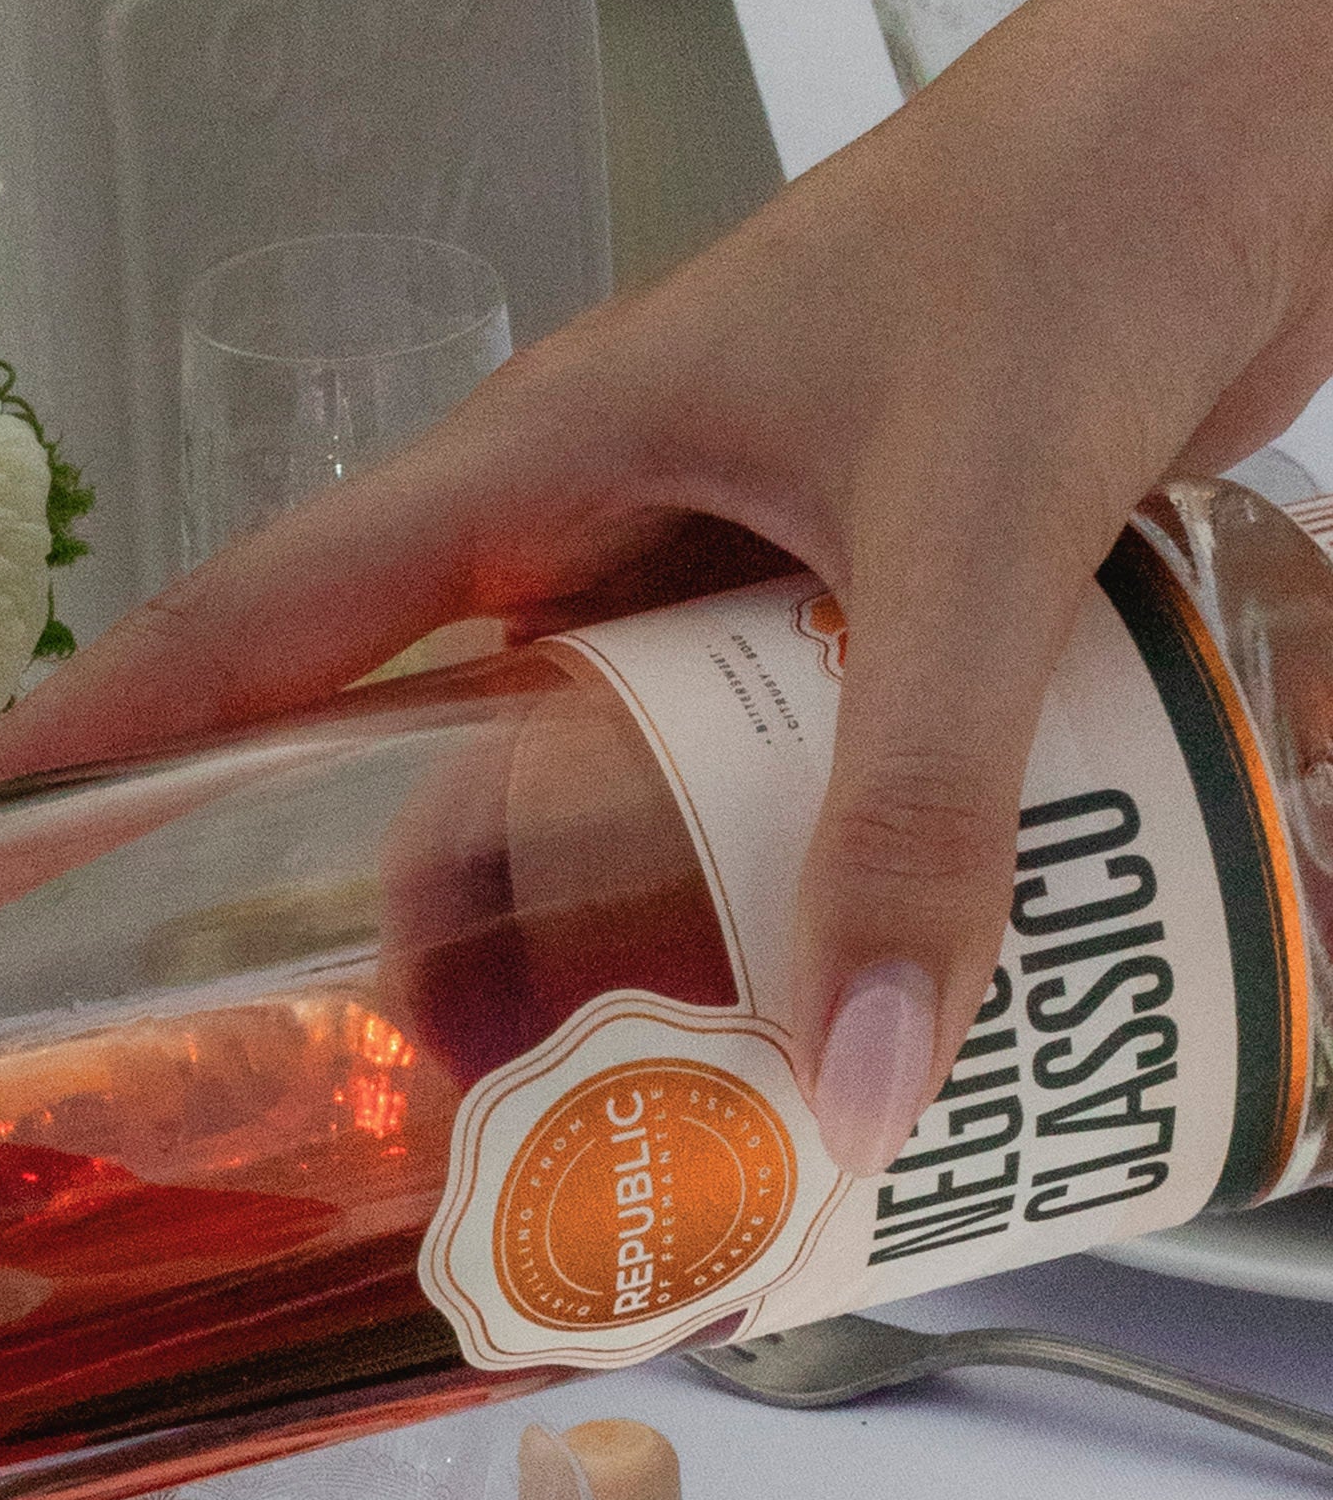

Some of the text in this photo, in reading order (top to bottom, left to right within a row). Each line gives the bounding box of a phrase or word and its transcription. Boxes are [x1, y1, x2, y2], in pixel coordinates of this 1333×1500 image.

[708, 652, 768, 734] BITTERSWEET
[758, 671, 800, 730] CITRUSY
[1009, 788, 1180, 1223] CLASSICO
[517, 1119, 591, 1317] DISTILLING FROM
[605, 1089, 656, 1316] REPUBLIC
[650, 1088, 674, 1304] OF FREMANTLE
[689, 1089, 772, 1287] GRAPE TO GLASS
